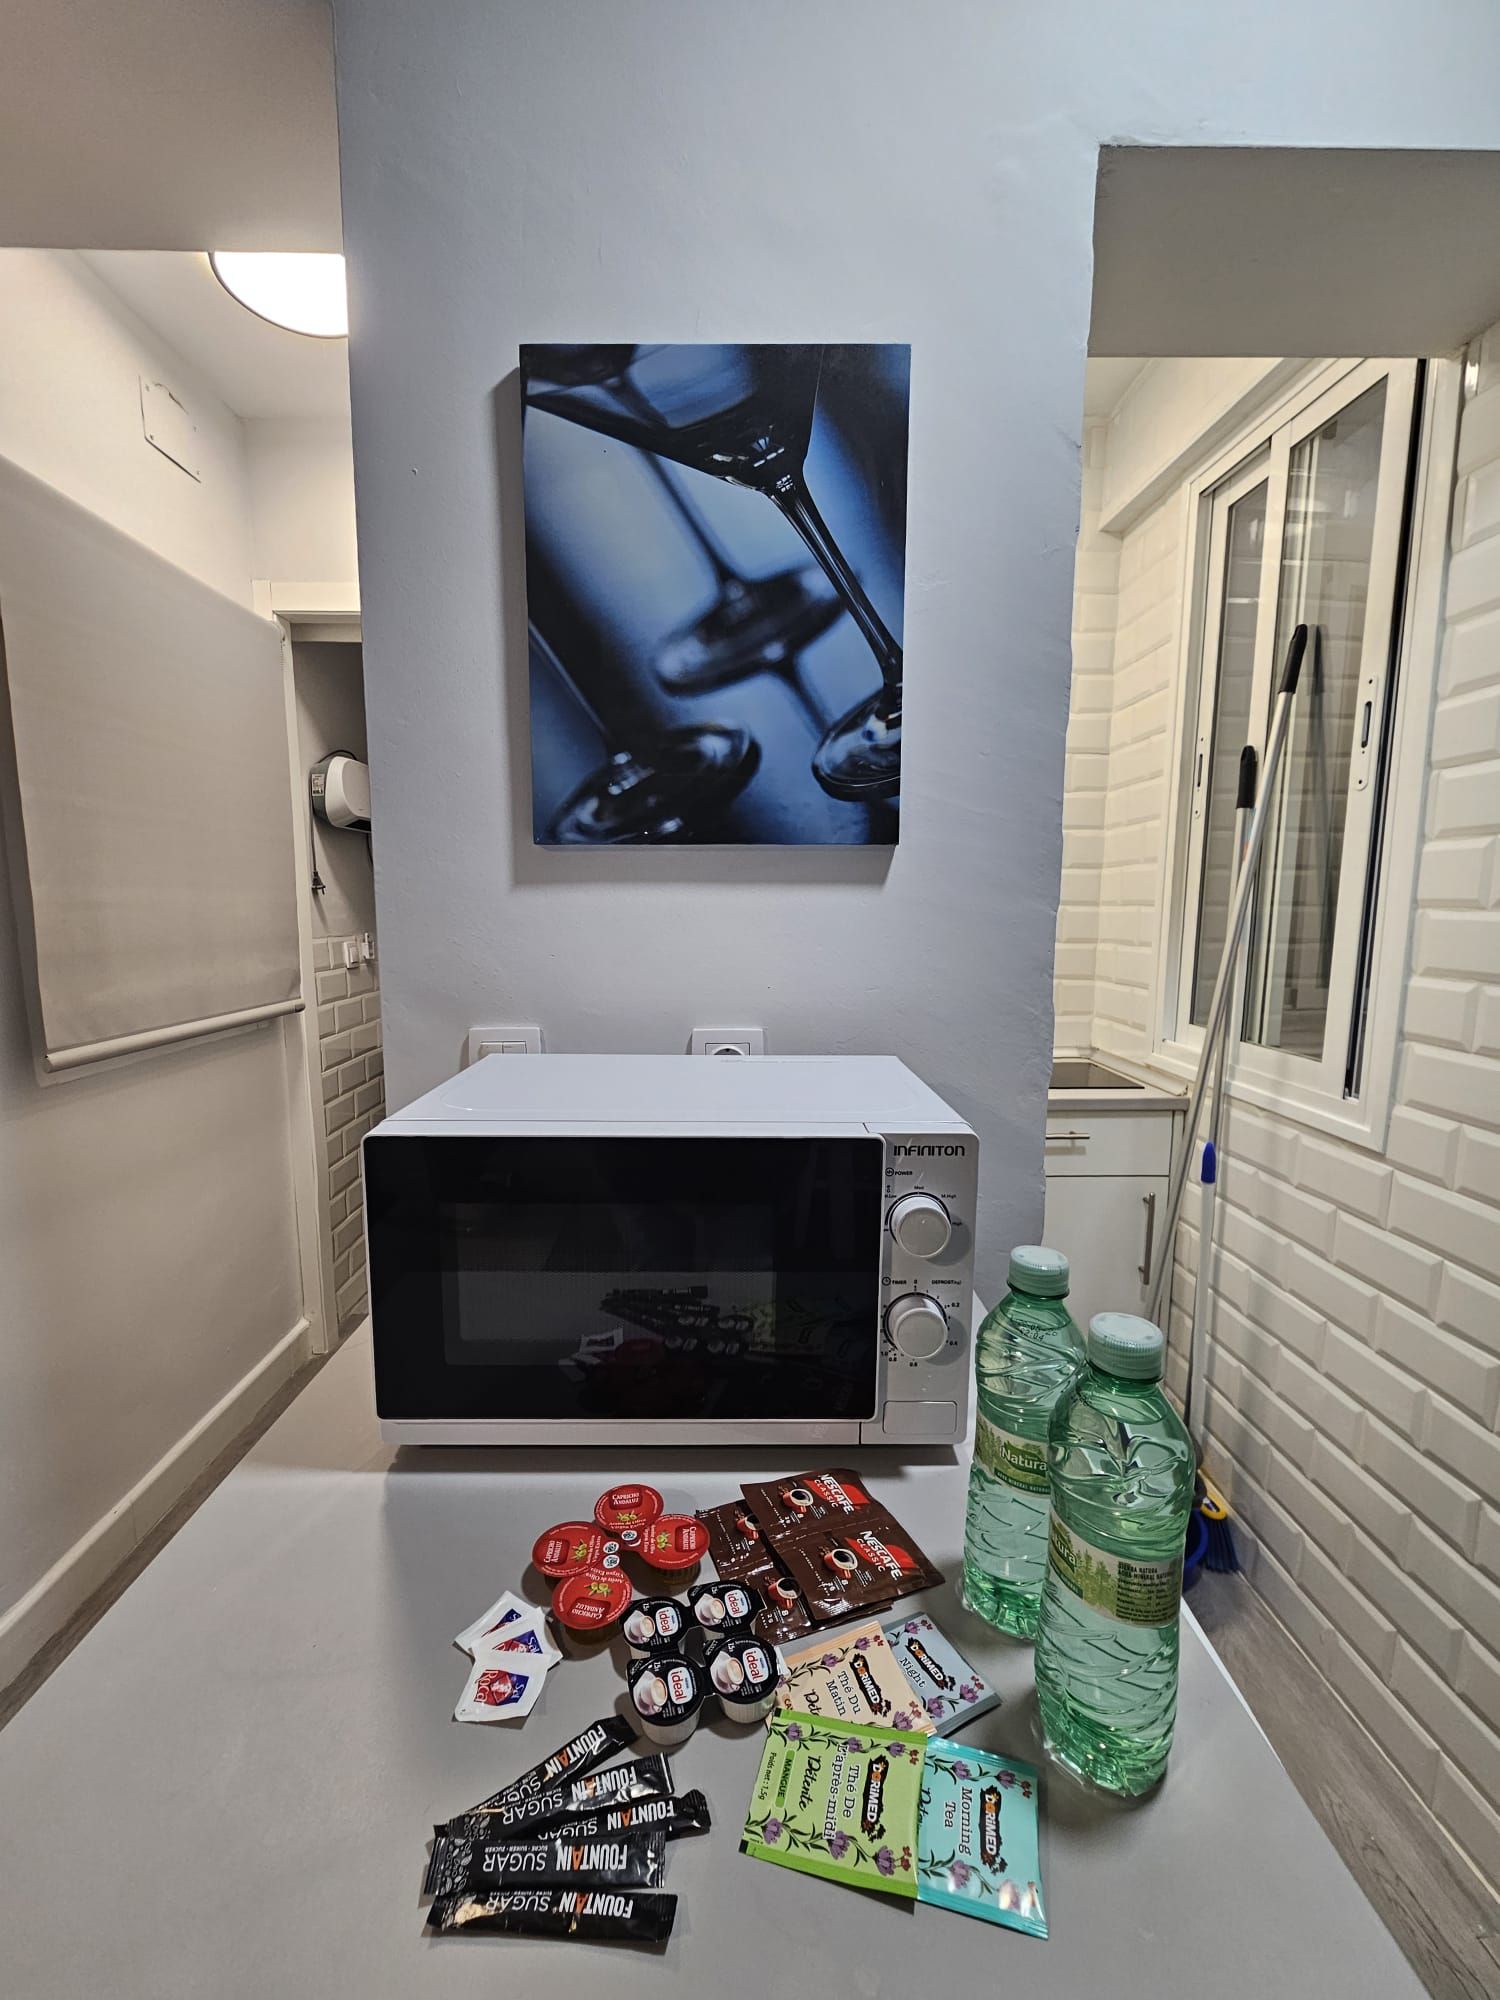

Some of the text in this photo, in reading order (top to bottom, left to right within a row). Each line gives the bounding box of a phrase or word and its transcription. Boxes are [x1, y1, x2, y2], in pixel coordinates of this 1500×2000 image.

[1002, 1447, 1047, 1471] Natura
[814, 1479, 839, 1509] CLASSIC
[856, 1538, 886, 1572] CLASSIC
[571, 1608, 603, 1620] CAPRICHO
[726, 1592, 744, 1617] ideal
[658, 1609, 673, 1633] ideal
[745, 1650, 763, 1681] ideal
[899, 1657, 927, 1689] Night
[670, 1670, 687, 1701] ideal
[826, 1679, 846, 1716] Matin
[837, 1670, 861, 1716] Thé Du
[544, 1724, 607, 1778] FOUNTAIN
[571, 1766, 638, 1802] FOUNTAIN
[777, 1758, 793, 1798] MANGUE
[842, 1764, 860, 1819] Thé De
[502, 1793, 563, 1825] SUGAR
[607, 1800, 675, 1831] FOUNTAIN
[944, 1801, 956, 1828] Tea
[958, 1786, 973, 1856] Morning
[482, 1852, 547, 1872] SUGAR
[556, 1844, 628, 1871] FOUNTAIN
[486, 1895, 551, 1912] SUGAR
[559, 1891, 634, 1919] FOUNTAIN
